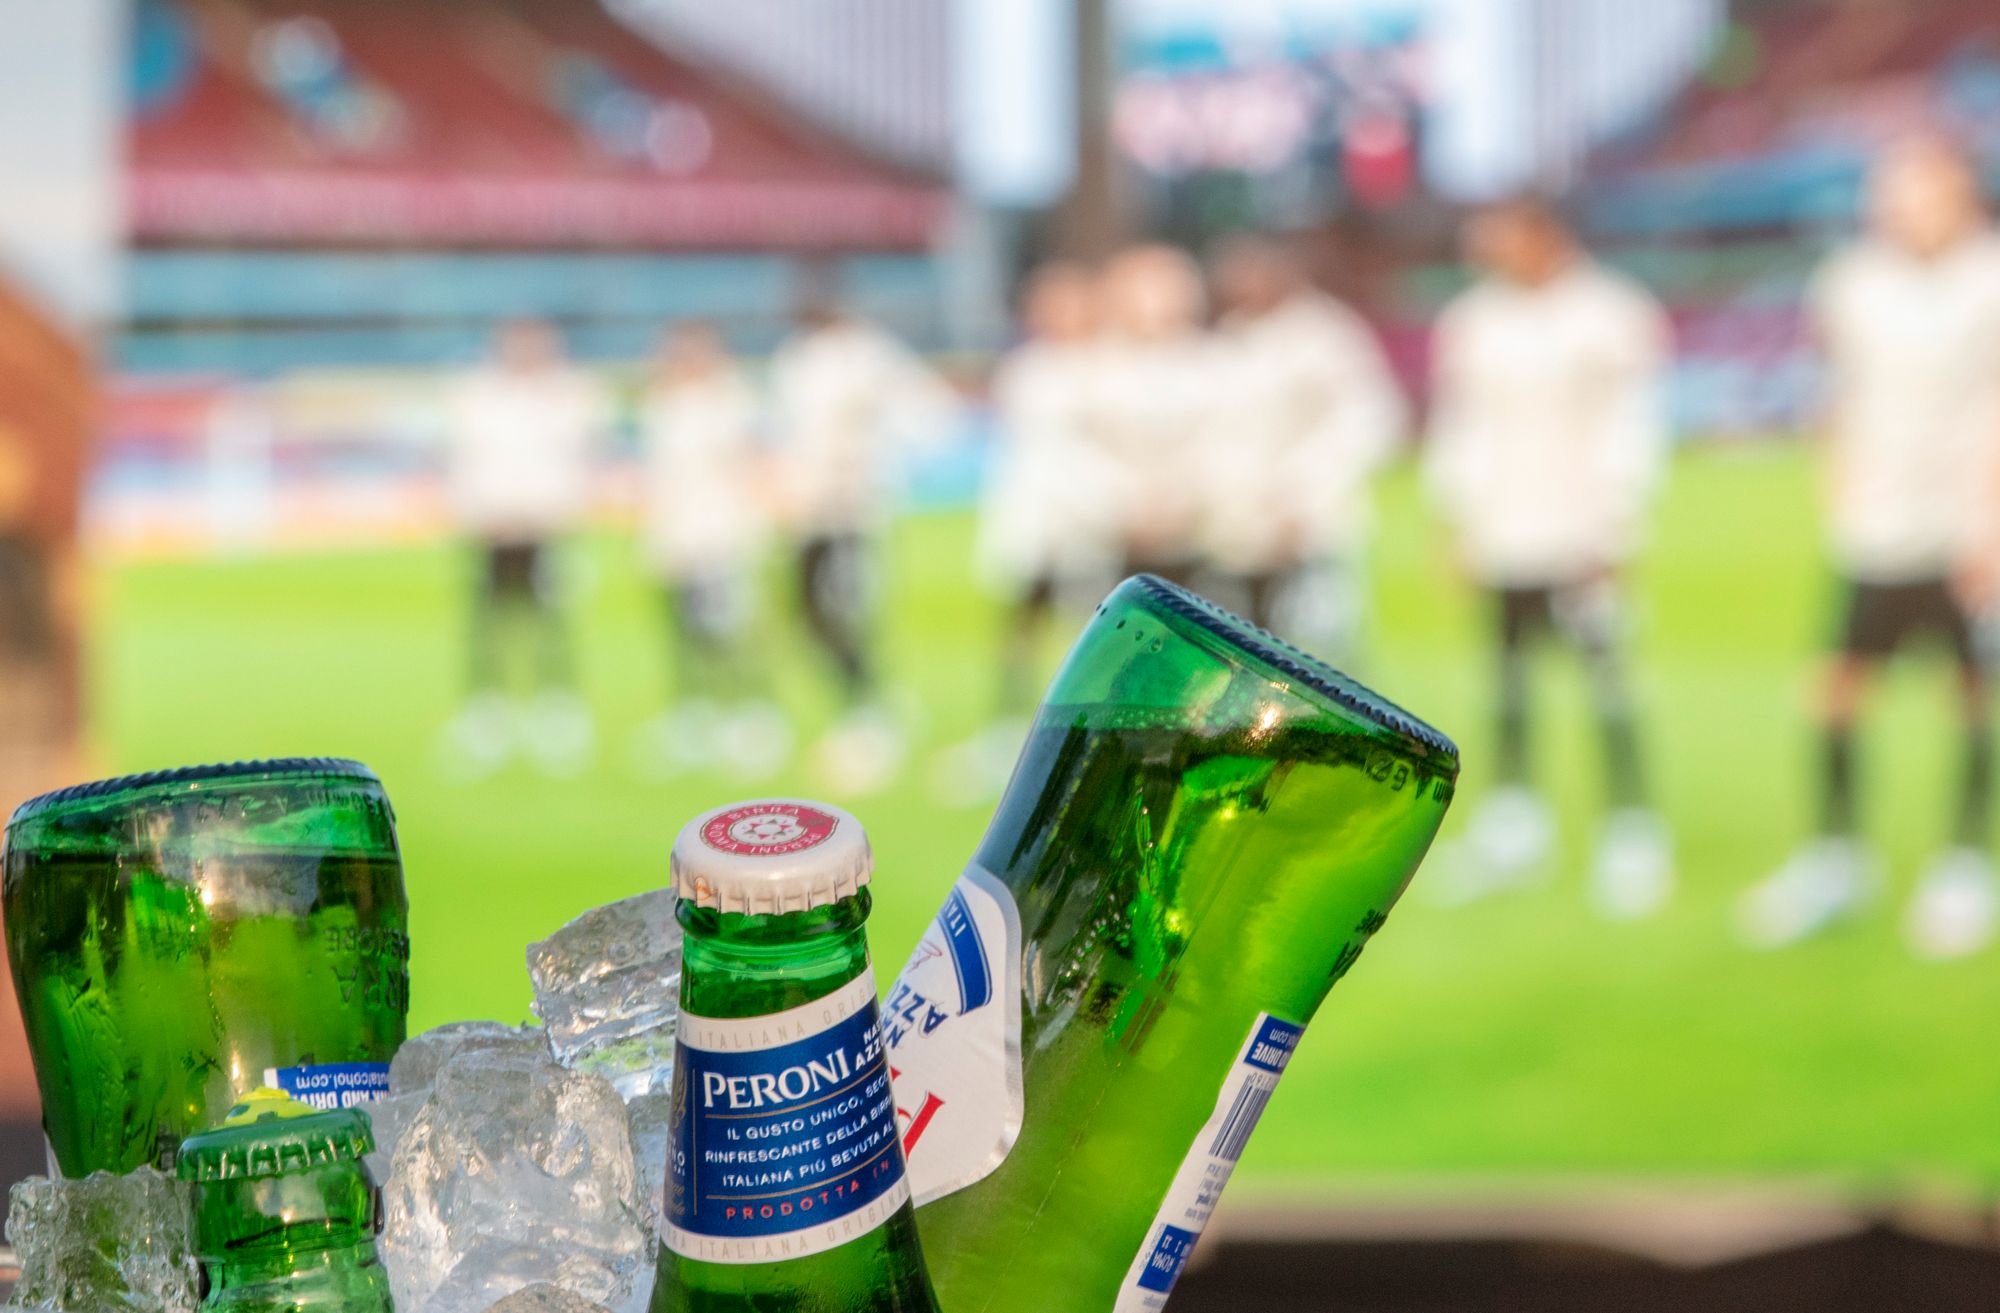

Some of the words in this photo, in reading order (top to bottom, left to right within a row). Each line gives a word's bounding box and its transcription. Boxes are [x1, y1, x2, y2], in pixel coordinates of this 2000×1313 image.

[728, 806, 798, 820] BIRRA
[750, 833, 822, 853] PERONI
[889, 984, 949, 1034] AZZ
[699, 1023, 806, 1049] ITALIANA
[855, 1037, 880, 1071] AZZ
[1251, 1041, 1283, 1067] DRIVE
[703, 1048, 851, 1108] PERONI
[293, 1091, 338, 1110] DRIV
[727, 1128, 740, 1141] IL
[746, 1118, 804, 1140] GUSTO
[810, 1095, 864, 1126] UNICO,
[705, 1136, 821, 1164] RINFRESCANTE
[826, 1115, 868, 1144] DELLA
[723, 1169, 793, 1187] ITALIANA
[800, 1159, 826, 1178] PIÙ
[831, 1131, 880, 1167] BEVUTA
[726, 1179, 860, 1220] PRODOTTA
[873, 1160, 889, 1179] IN
[699, 1236, 808, 1258] ITALIANA
[1152, 1250, 1175, 1273] ROMA
